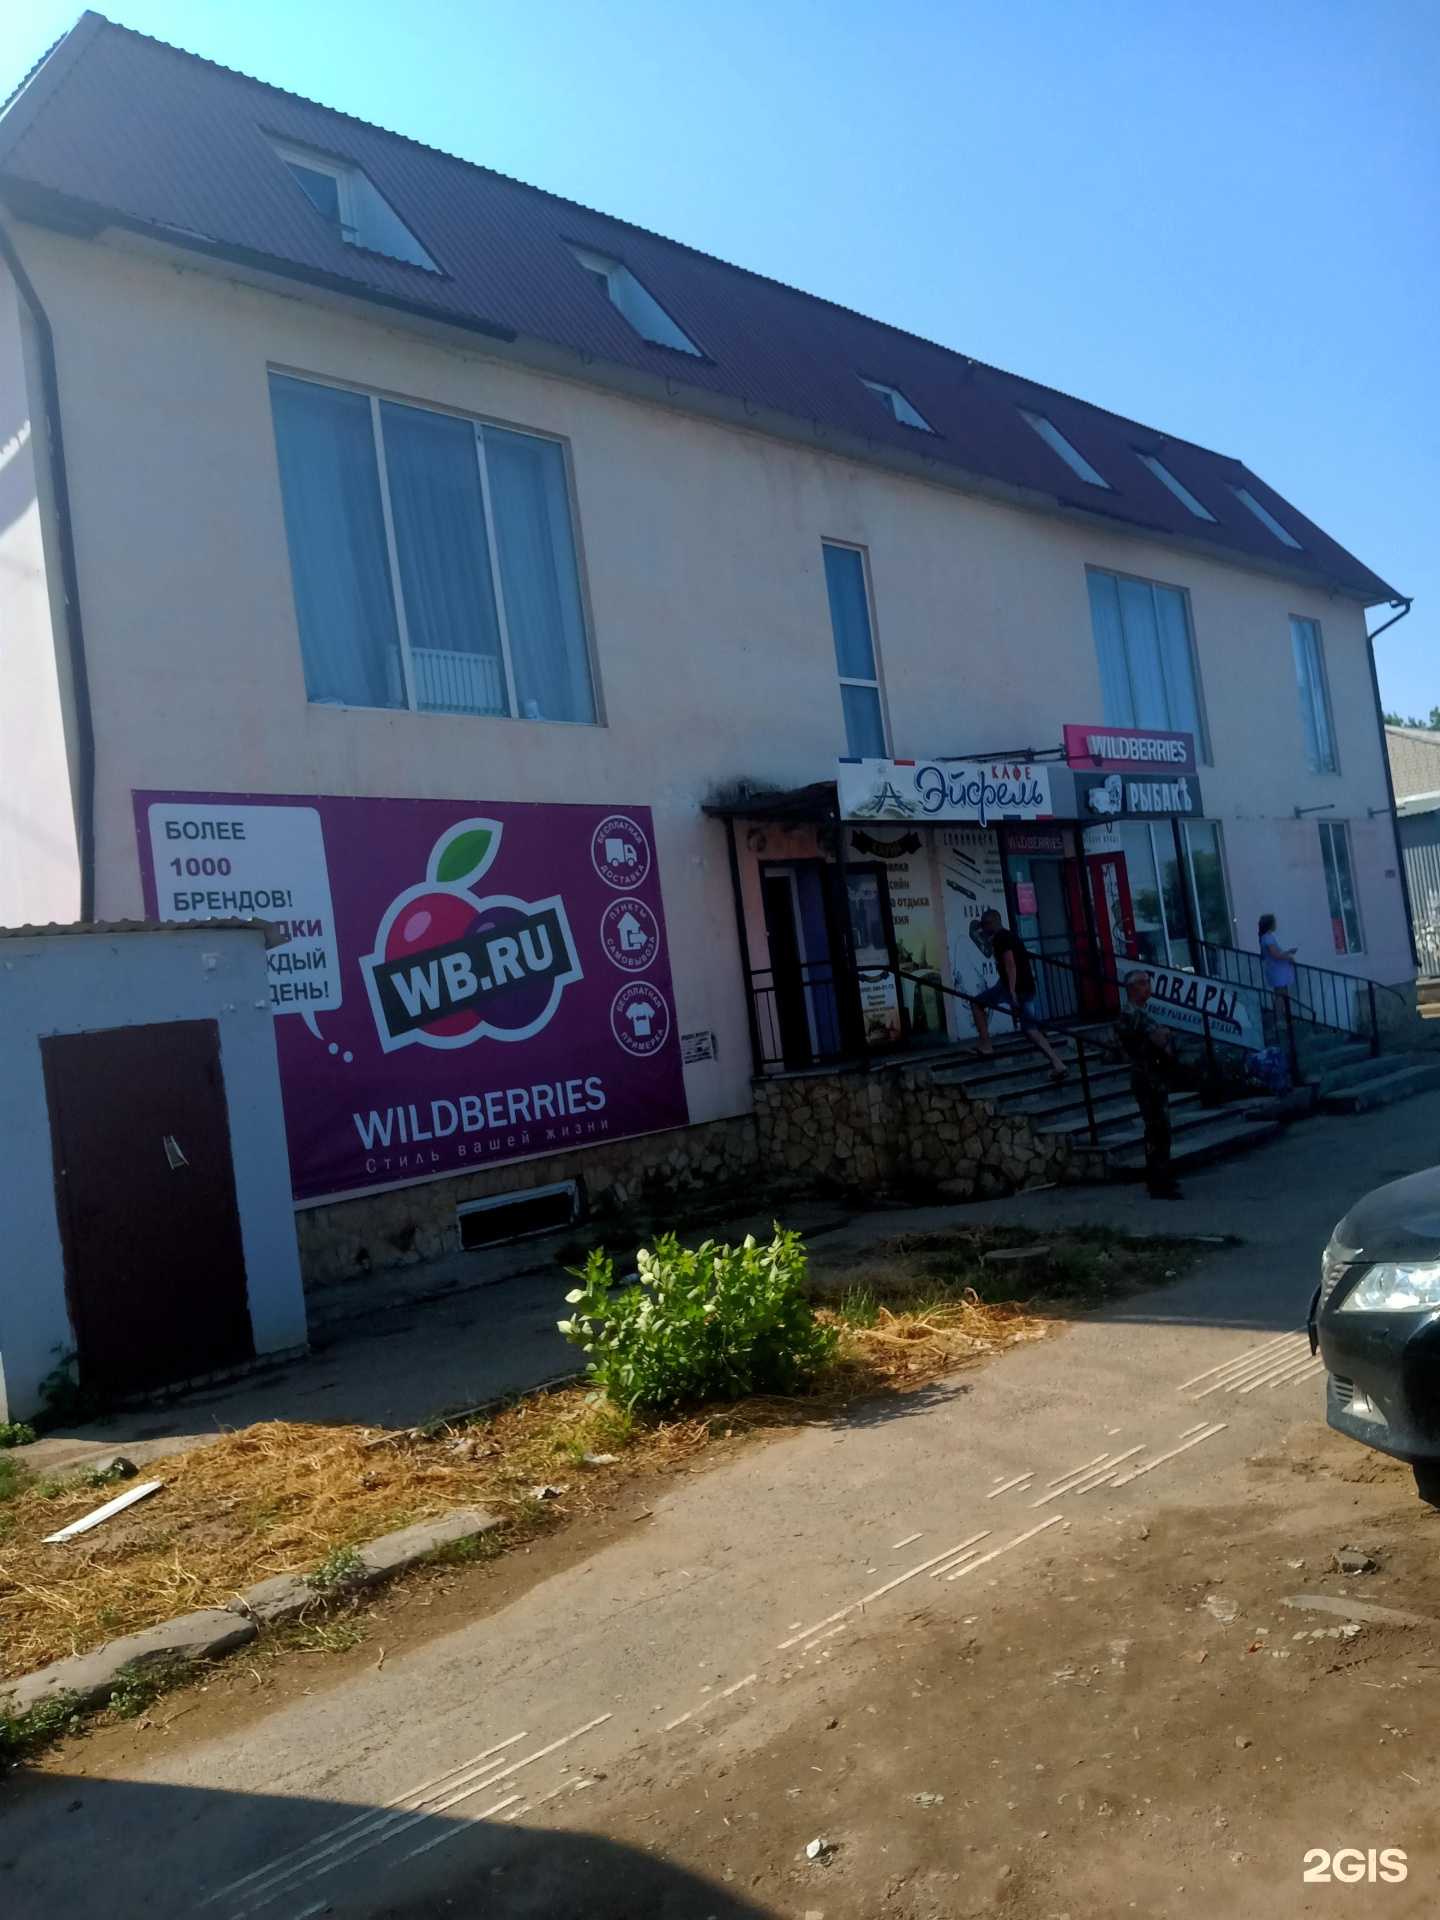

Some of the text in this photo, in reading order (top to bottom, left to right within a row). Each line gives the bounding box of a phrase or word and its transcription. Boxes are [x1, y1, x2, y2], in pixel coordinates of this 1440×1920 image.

[1089, 735, 1187, 764] WILDBERRIES
[990, 765, 1032, 783] КАФЕ
[916, 766, 1044, 827] Эйфель
[165, 821, 246, 841] БОЛЕЕ
[597, 820, 643, 844] БЕСПЛАТНАЯ
[170, 857, 232, 877] 1000
[600, 864, 645, 884] ДОСТАВКА
[173, 889, 294, 912] БРЕНДОВ!
[608, 903, 647, 920] ПУНКТЫ
[278, 919, 323, 941] ДКИ
[391, 924, 554, 1018] WB.RU
[616, 987, 662, 1013] БЕСПЛАТНАЯ
[620, 1029, 664, 1050] ПРИМЕРКА
[353, 1075, 608, 1151] WILDBERRIES
[366, 1119, 609, 1175] Стиль вашей жизни
